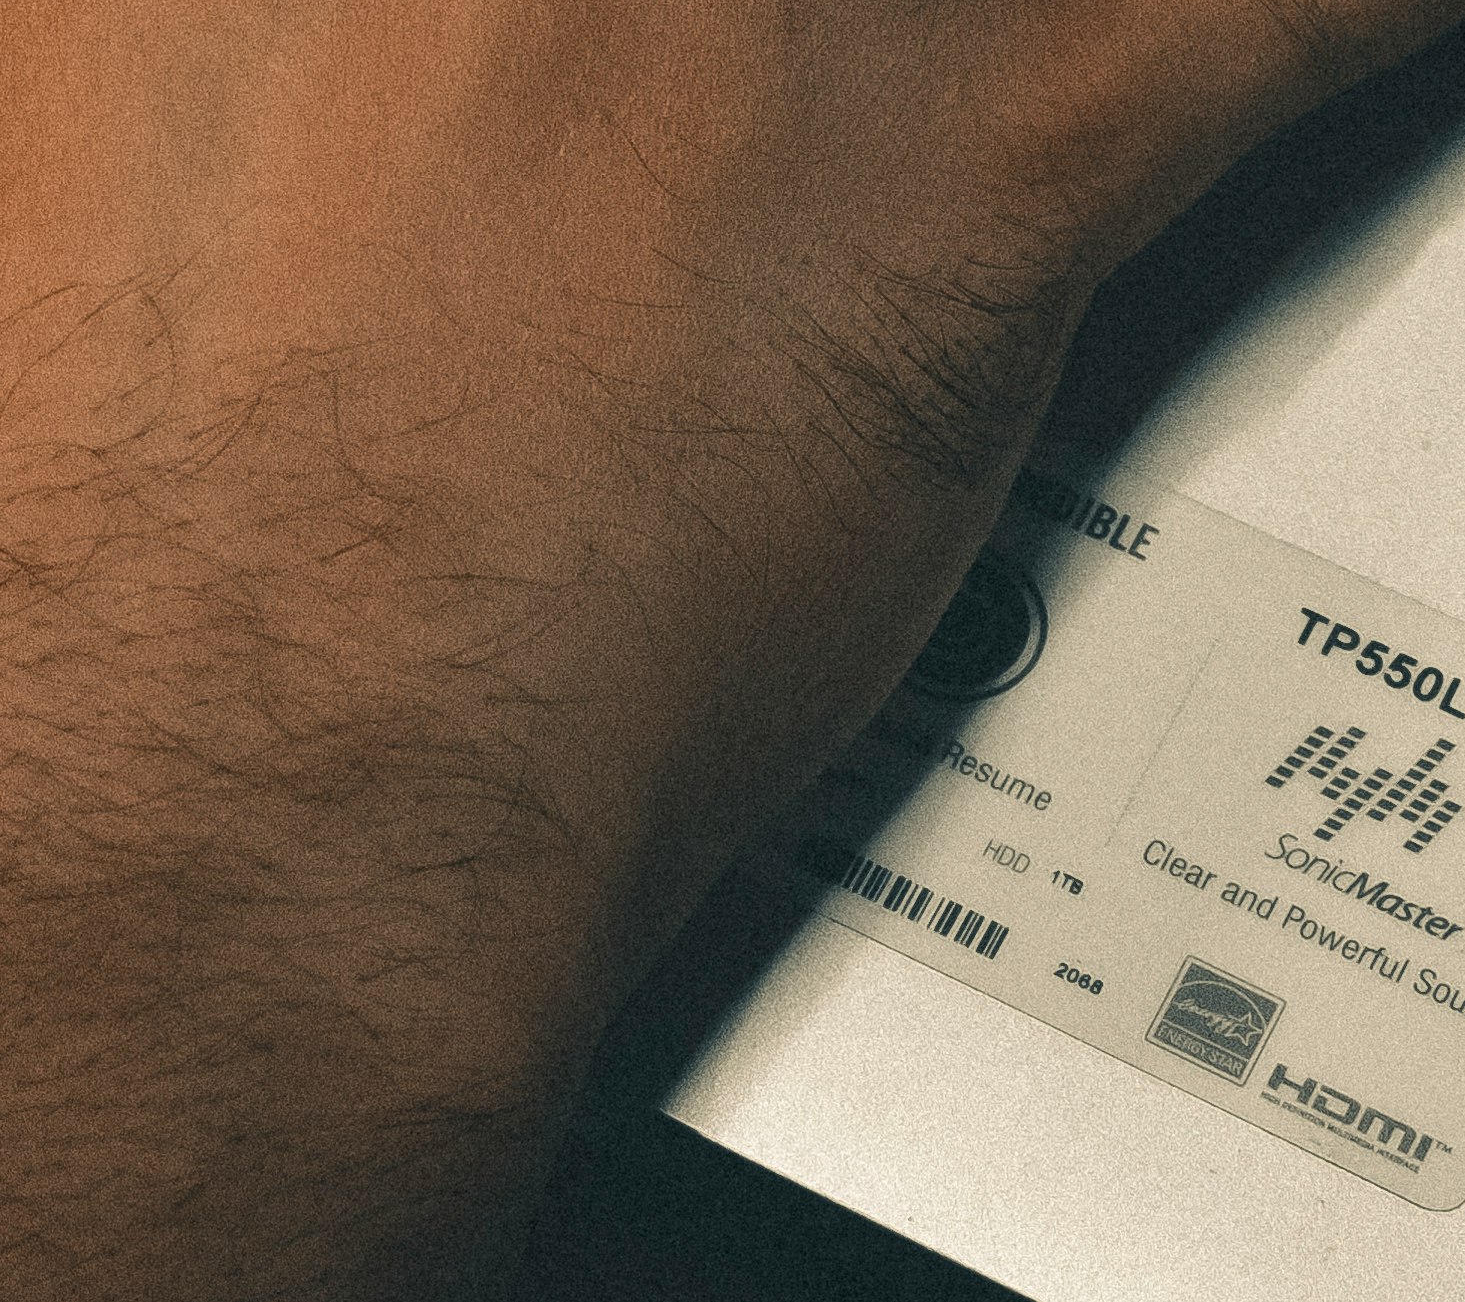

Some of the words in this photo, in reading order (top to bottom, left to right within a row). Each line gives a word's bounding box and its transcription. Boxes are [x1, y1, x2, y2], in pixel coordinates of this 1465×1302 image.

[1298, 608, 1465, 719] TP550L
[943, 740, 1054, 811] Resume
[982, 839, 1033, 875] HDD
[1141, 838, 1218, 890] Clear
[1219, 877, 1279, 922] and
[1281, 903, 1410, 985] Powerful
[1263, 832, 1464, 943] SonicMaster
